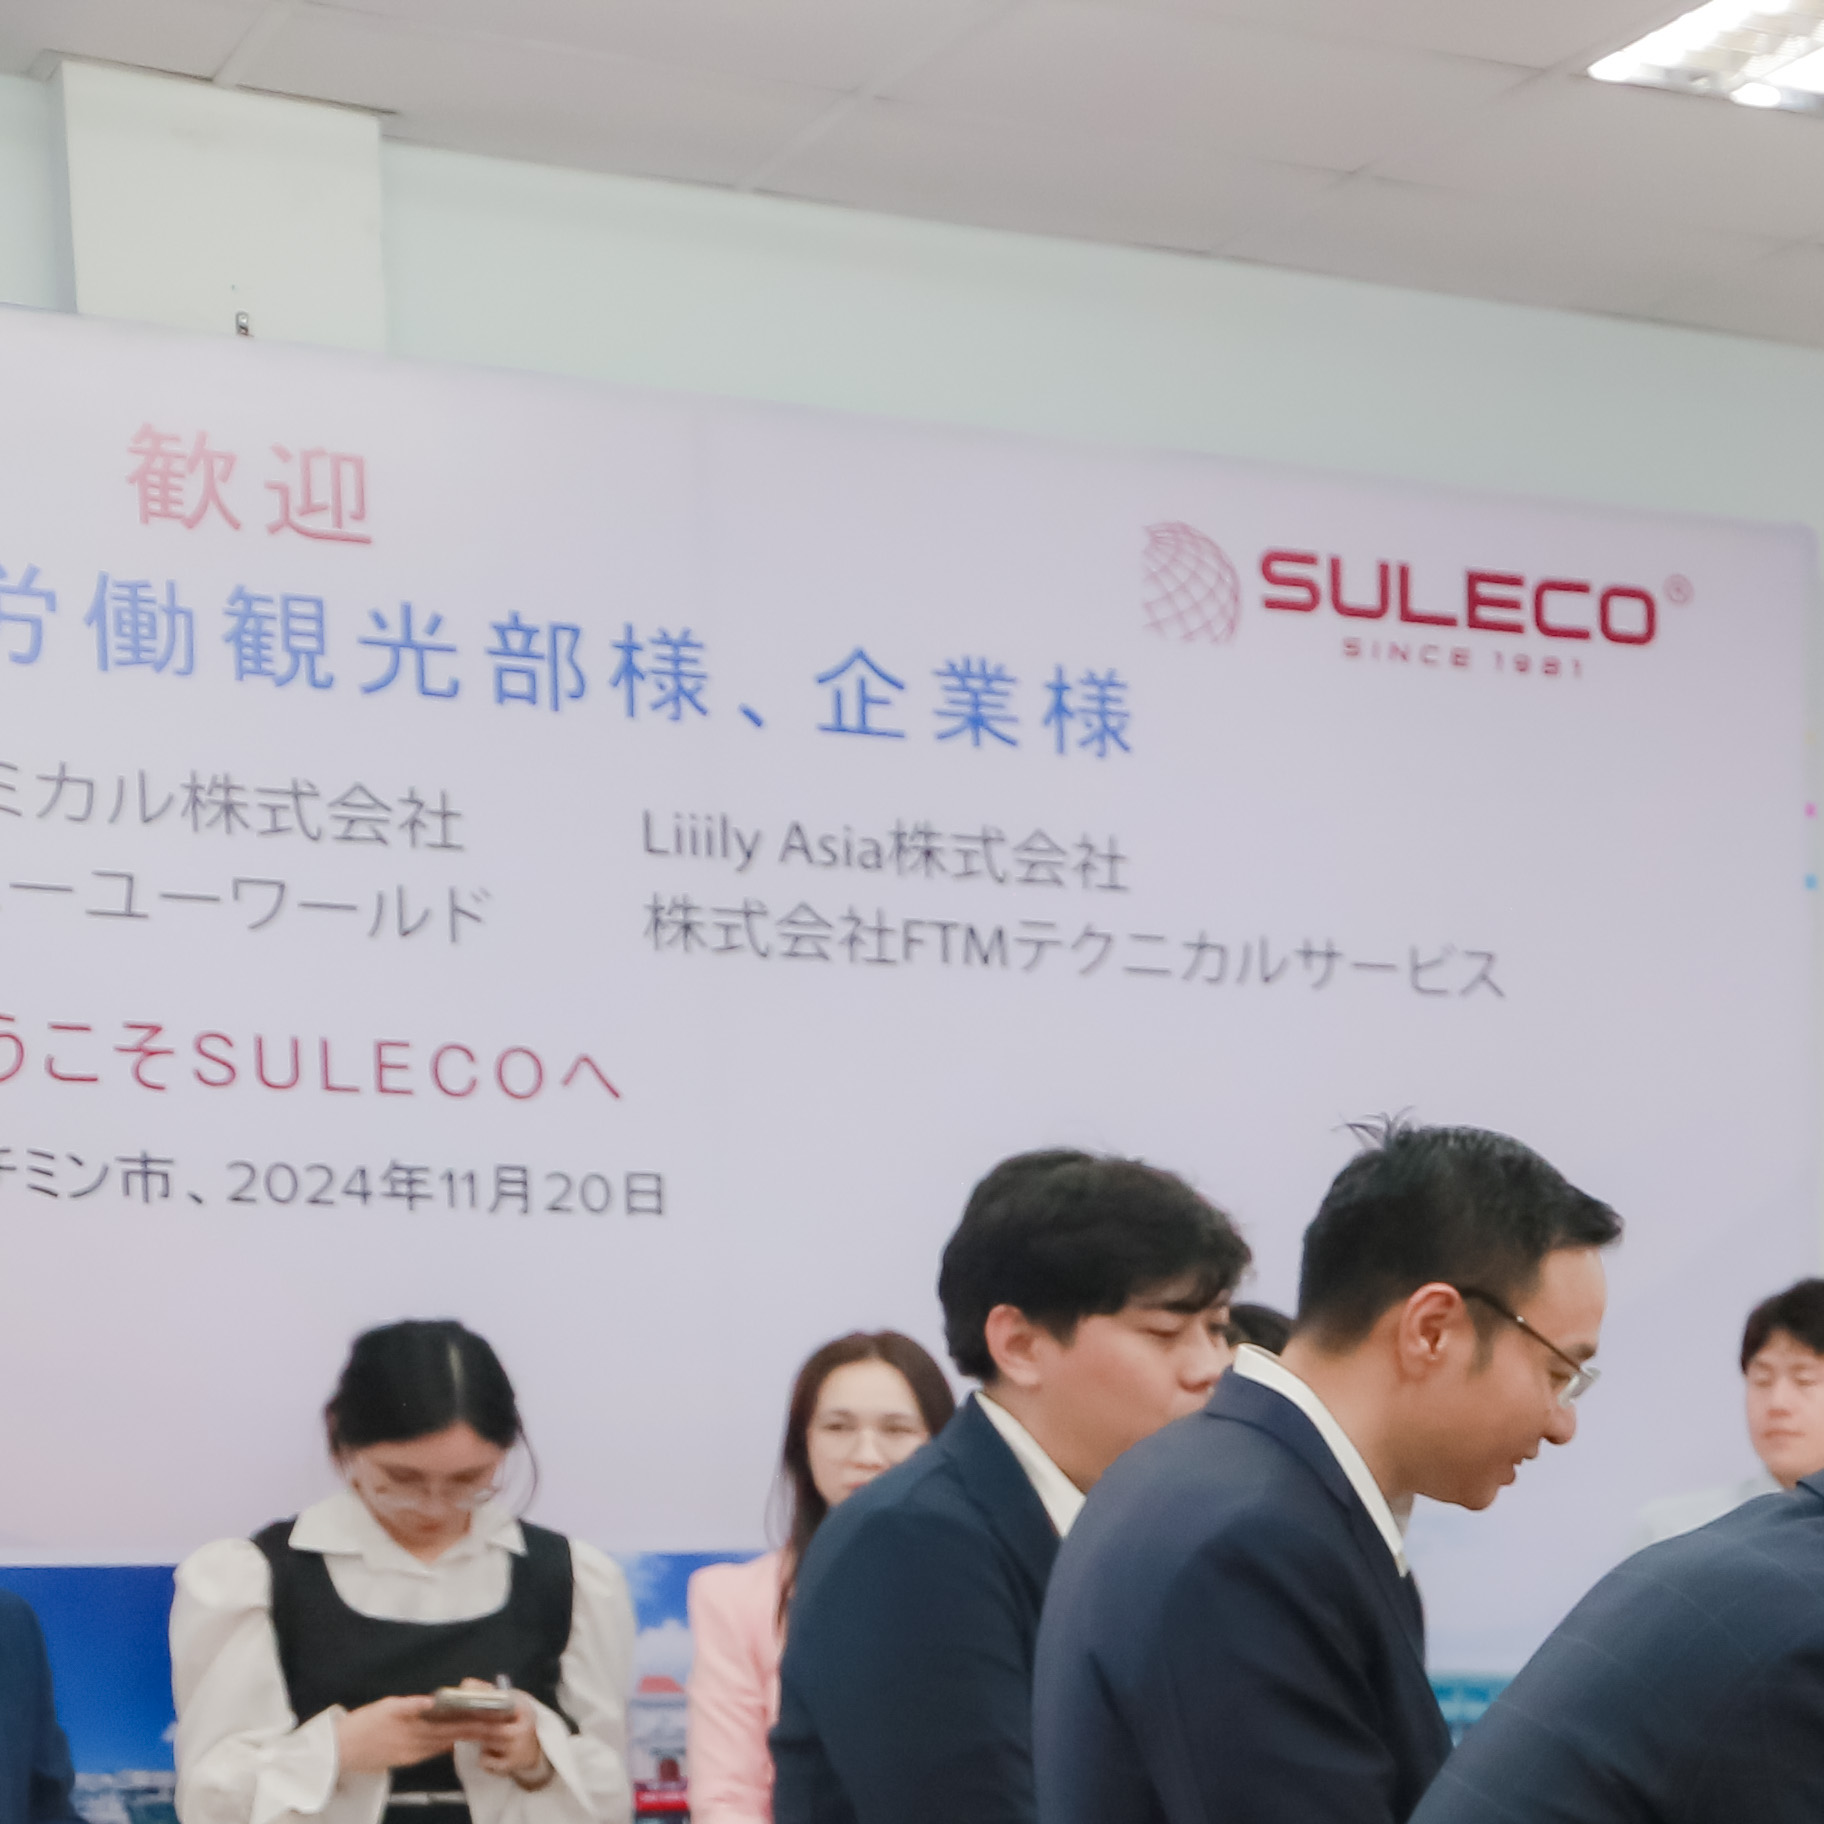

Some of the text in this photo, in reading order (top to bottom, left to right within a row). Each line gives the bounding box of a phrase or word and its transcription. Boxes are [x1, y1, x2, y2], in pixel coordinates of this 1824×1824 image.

[126, 421, 374, 547] 歓迎
[1260, 549, 1660, 649] SULECO
[1342, 635, 1584, 680] SINCE 1981
[778, 818, 1132, 896] Asia株式会社
[644, 891, 1508, 1002] 株式会社FTMテクニカルサービス
